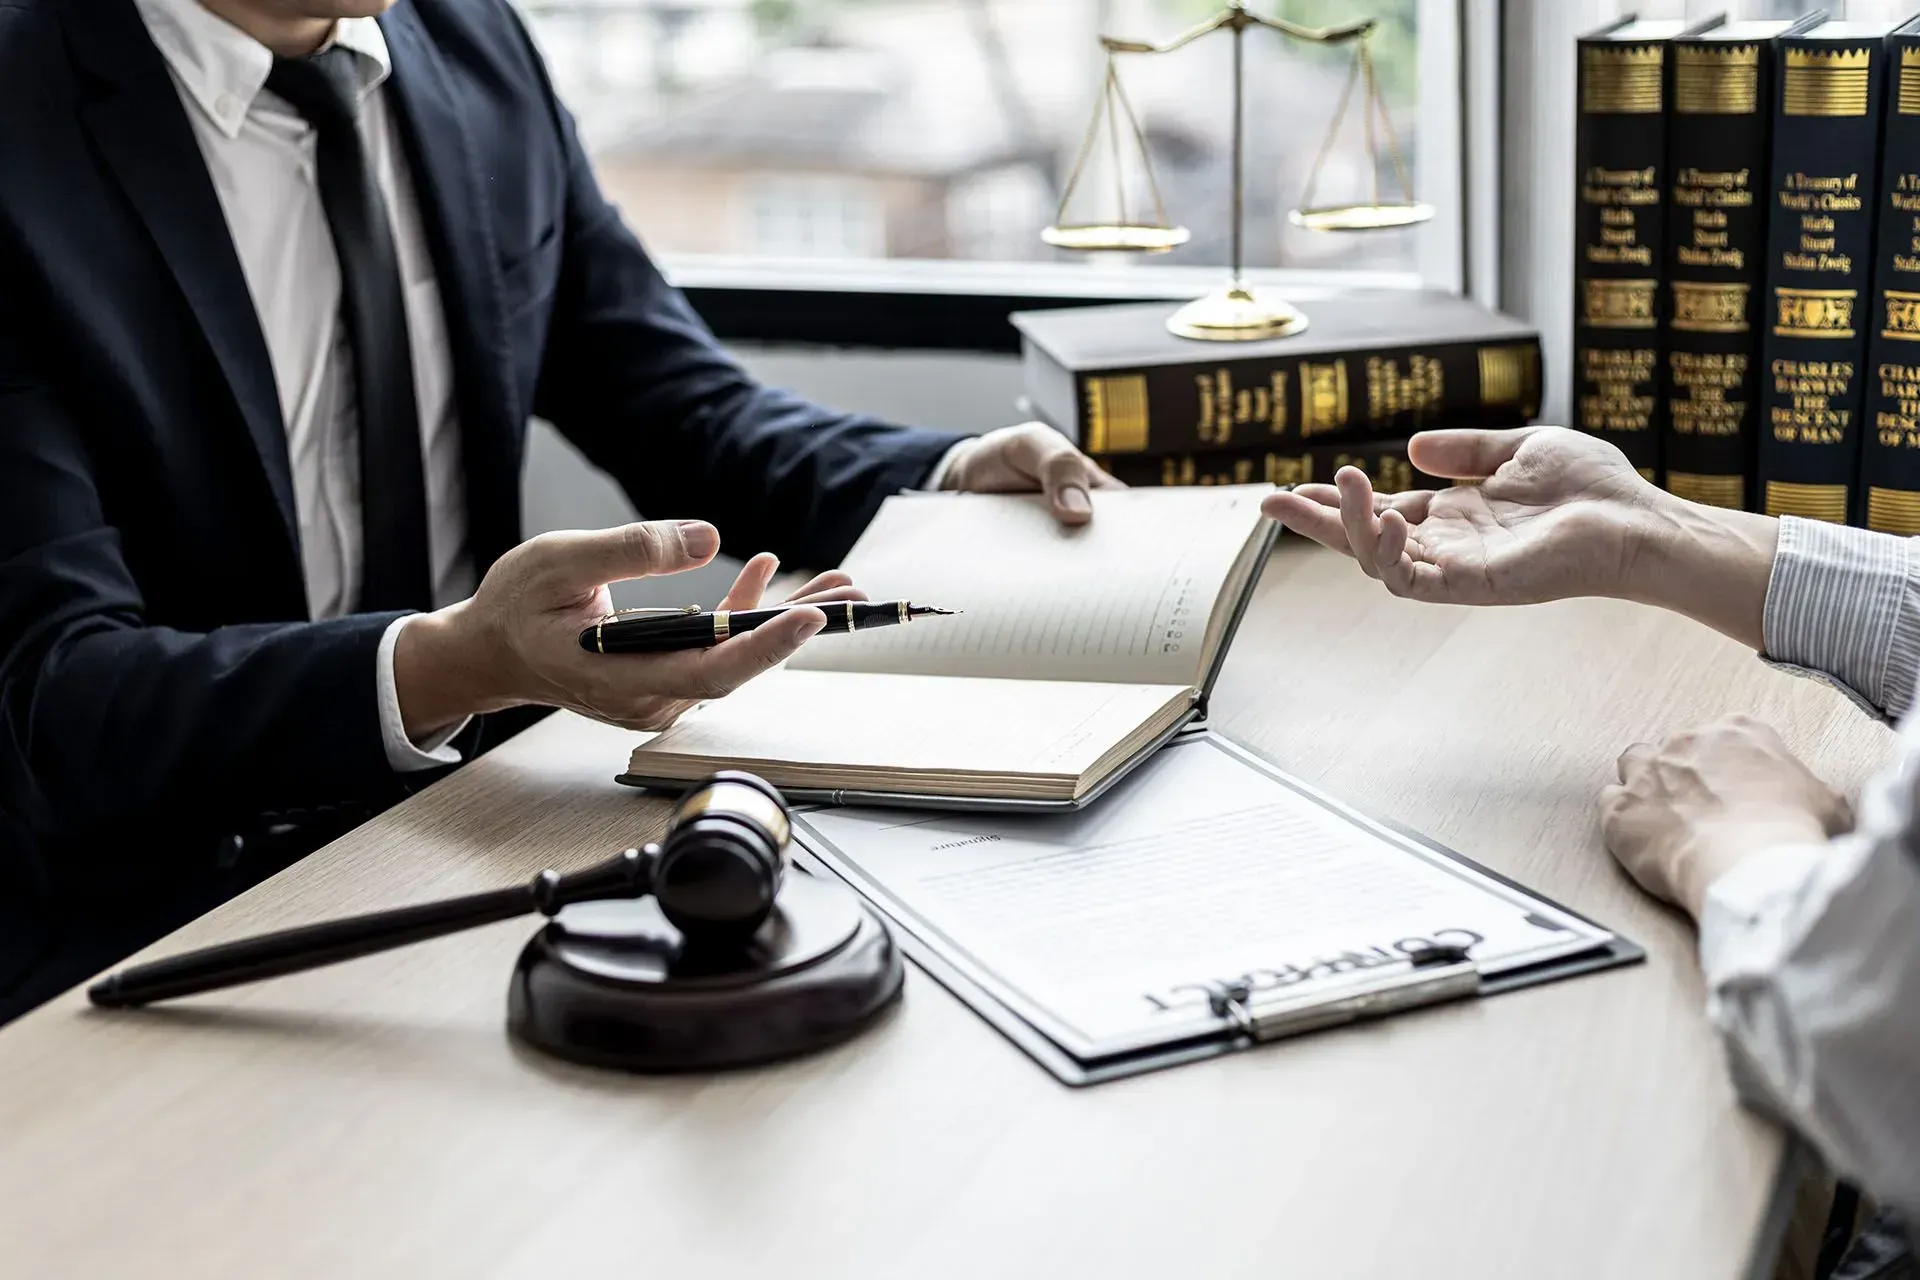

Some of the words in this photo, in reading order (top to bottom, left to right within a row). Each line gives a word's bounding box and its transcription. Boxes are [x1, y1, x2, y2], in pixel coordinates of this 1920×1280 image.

[1844, 173, 1858, 190] of
[1772, 359, 1853, 379] CHARLES
[1775, 376, 1848, 396] DARWIN
[1793, 394, 1829, 411] THE
[1771, 407, 1852, 427] DESCENT
[1774, 426, 1798, 442] OF
[1800, 427, 1844, 444] MAN
[931, 834, 1002, 852] Signature
